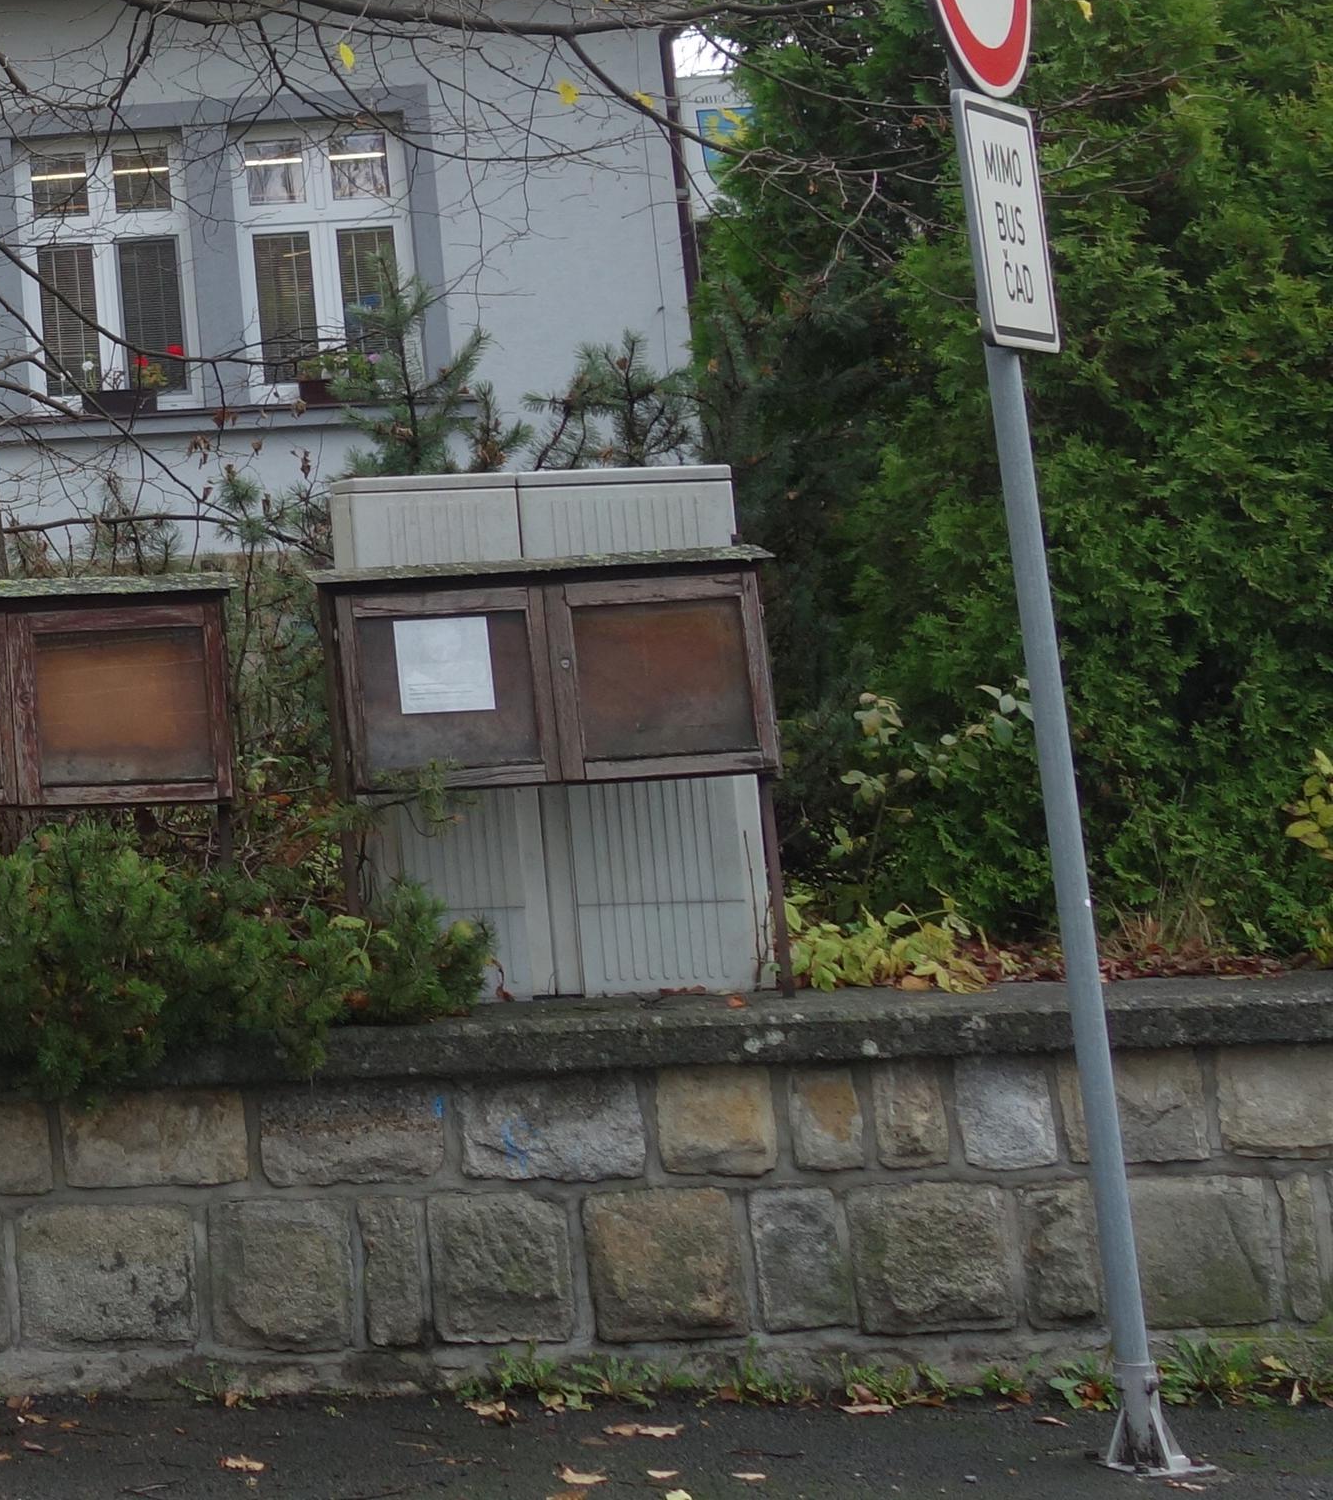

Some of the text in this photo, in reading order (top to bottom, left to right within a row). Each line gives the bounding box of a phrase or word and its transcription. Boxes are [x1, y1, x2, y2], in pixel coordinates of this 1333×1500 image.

[982, 138, 1023, 189] MIMO
[995, 200, 1026, 247] BUS
[1002, 248, 1034, 305] ČAD
